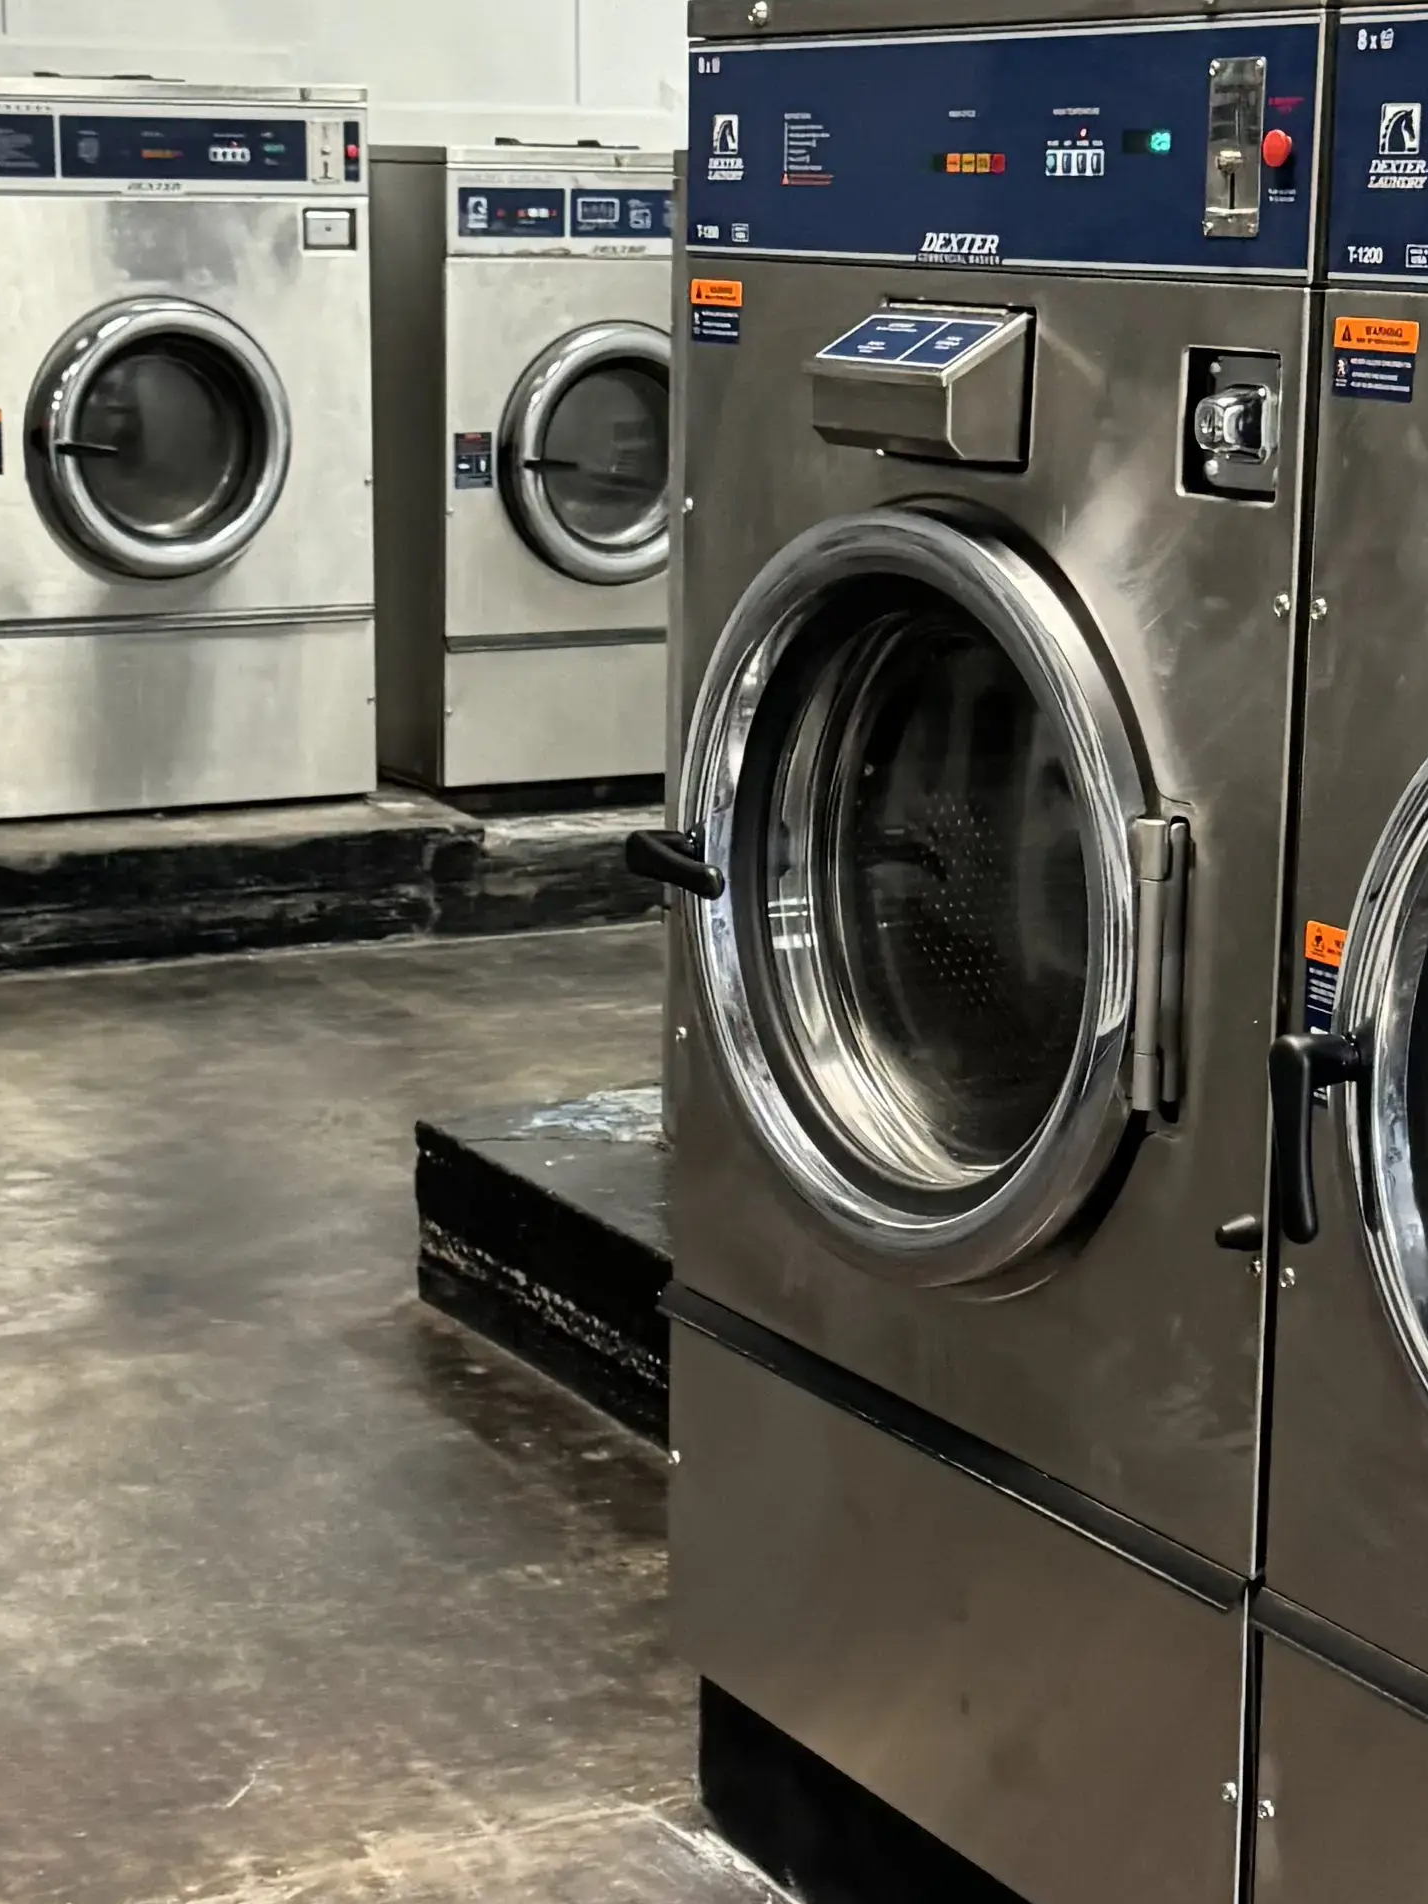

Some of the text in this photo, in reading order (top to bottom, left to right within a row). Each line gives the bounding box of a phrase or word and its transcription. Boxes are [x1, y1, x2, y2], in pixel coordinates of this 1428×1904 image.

[1369, 160, 1427, 174] DEXTER
[920, 232, 1000, 254] DEXTER
[1348, 246, 1384, 264] T-1200
